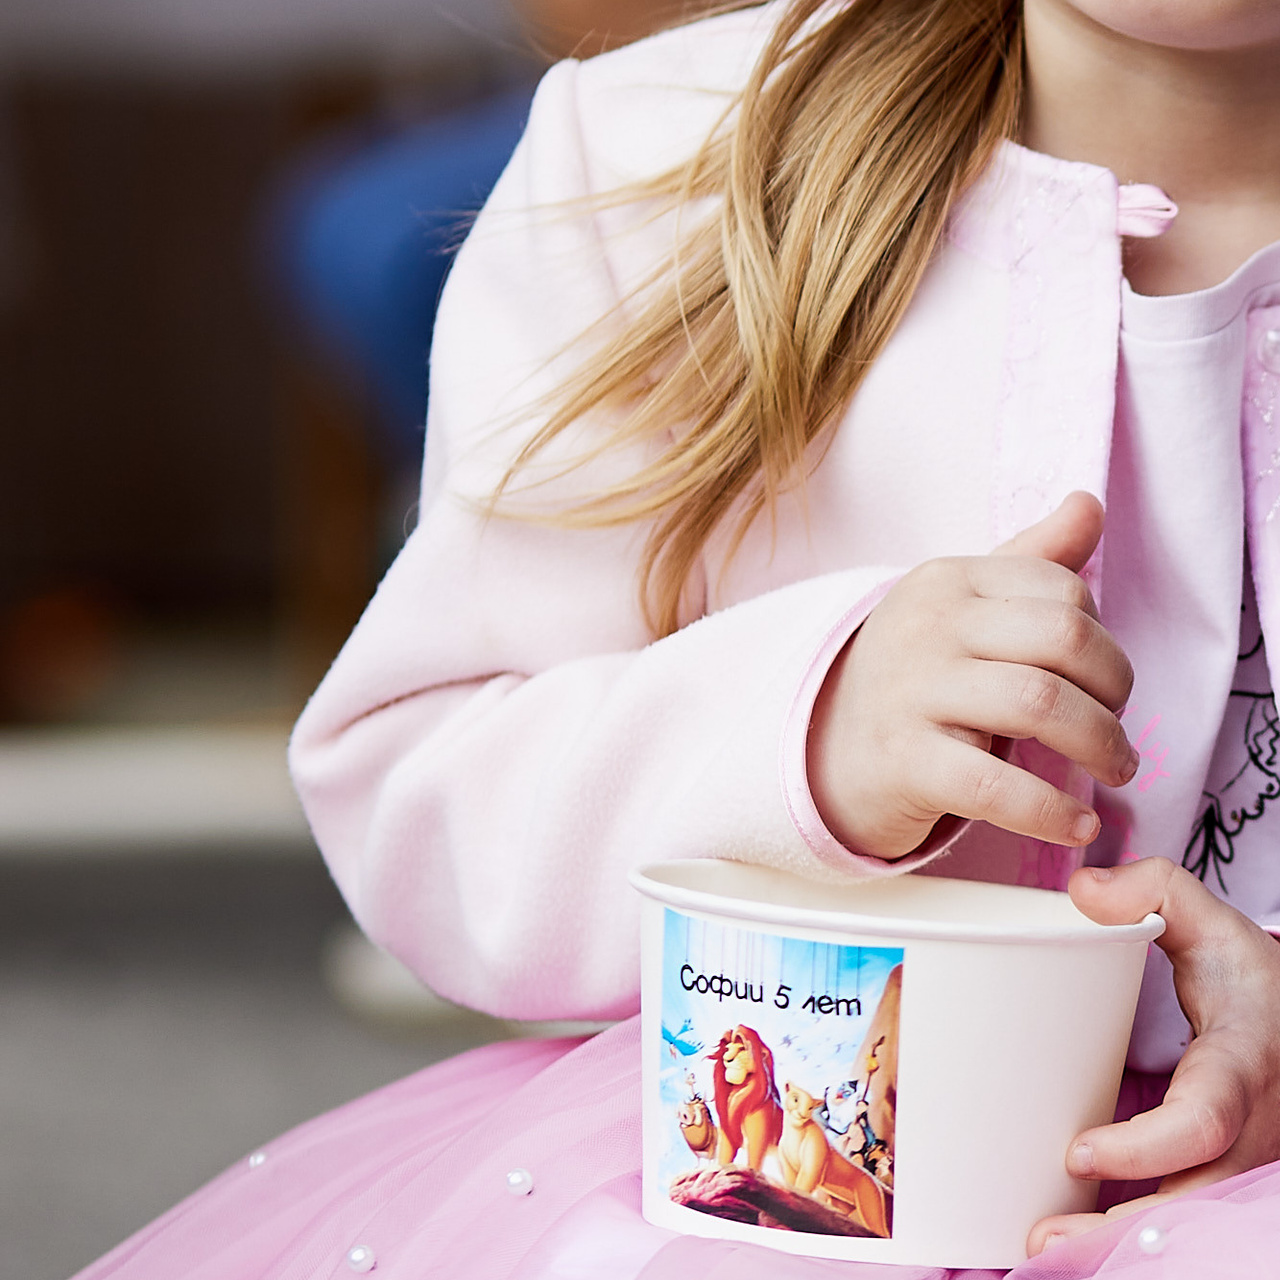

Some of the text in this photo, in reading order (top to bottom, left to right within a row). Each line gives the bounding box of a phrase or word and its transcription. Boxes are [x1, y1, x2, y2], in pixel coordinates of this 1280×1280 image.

[680, 963, 862, 1017] Софии 5 лет
